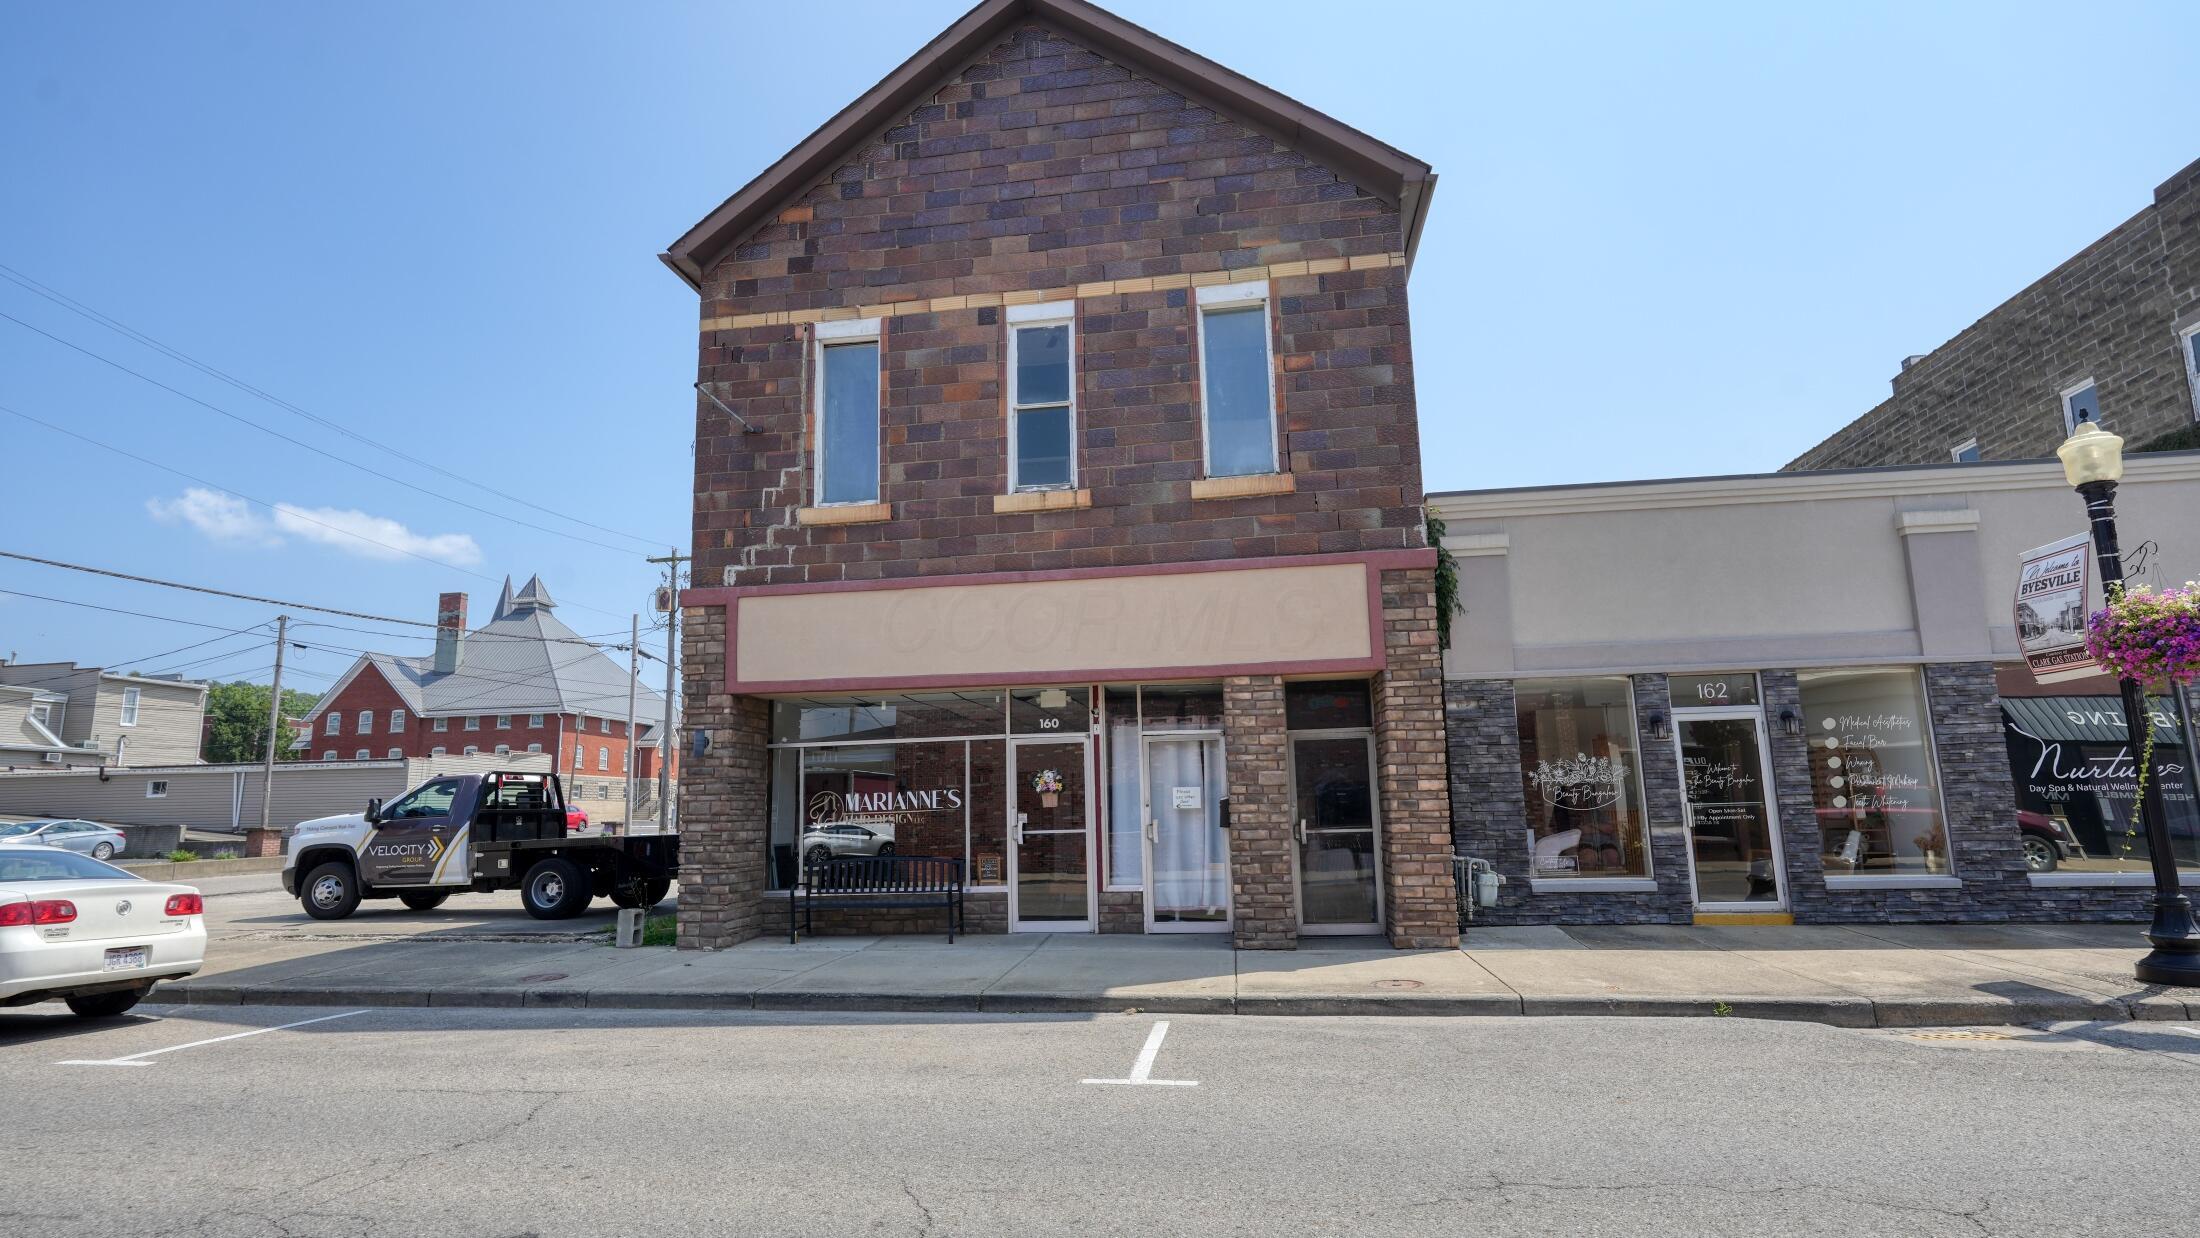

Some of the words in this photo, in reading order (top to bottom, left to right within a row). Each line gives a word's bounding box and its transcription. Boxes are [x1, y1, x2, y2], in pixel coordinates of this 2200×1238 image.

[2025, 560, 2069, 580] Welcome
[2070, 554, 2080, 567] to
[2021, 570, 2080, 595] BYESVILLE
[2032, 656, 2051, 668] CLARK
[2051, 655, 2064, 665] GAS
[2063, 651, 2090, 663] STATION
[1696, 682, 1728, 699] 162
[1039, 718, 1059, 729] 160
[1839, 715, 1870, 731] Medical
[1873, 714, 1912, 730] Aesthetics
[1843, 735, 1866, 750] Facial
[1868, 735, 1887, 749] Bar
[2009, 723, 2169, 779] Nurtue
[1707, 763, 1732, 774] Welcome
[1846, 755, 1874, 772] Waxing
[1704, 774, 1727, 789] Beauty
[1726, 774, 1755, 788] Bungalow
[1887, 774, 1918, 789] Makeup
[2029, 784, 2046, 793] Day
[2048, 784, 2066, 794] Spa
[2067, 783, 2074, 791] &
[2076, 783, 2110, 791] Natural
[845, 789, 961, 811] MARIANNE'S
[1552, 785, 1581, 805] Beauty
[1582, 785, 1617, 804] Bungalow
[1850, 793, 1870, 810] Teeth
[1871, 795, 1909, 811] Whitening
[874, 813, 913, 824] DESIGN
[369, 844, 426, 856] VELOCITY
